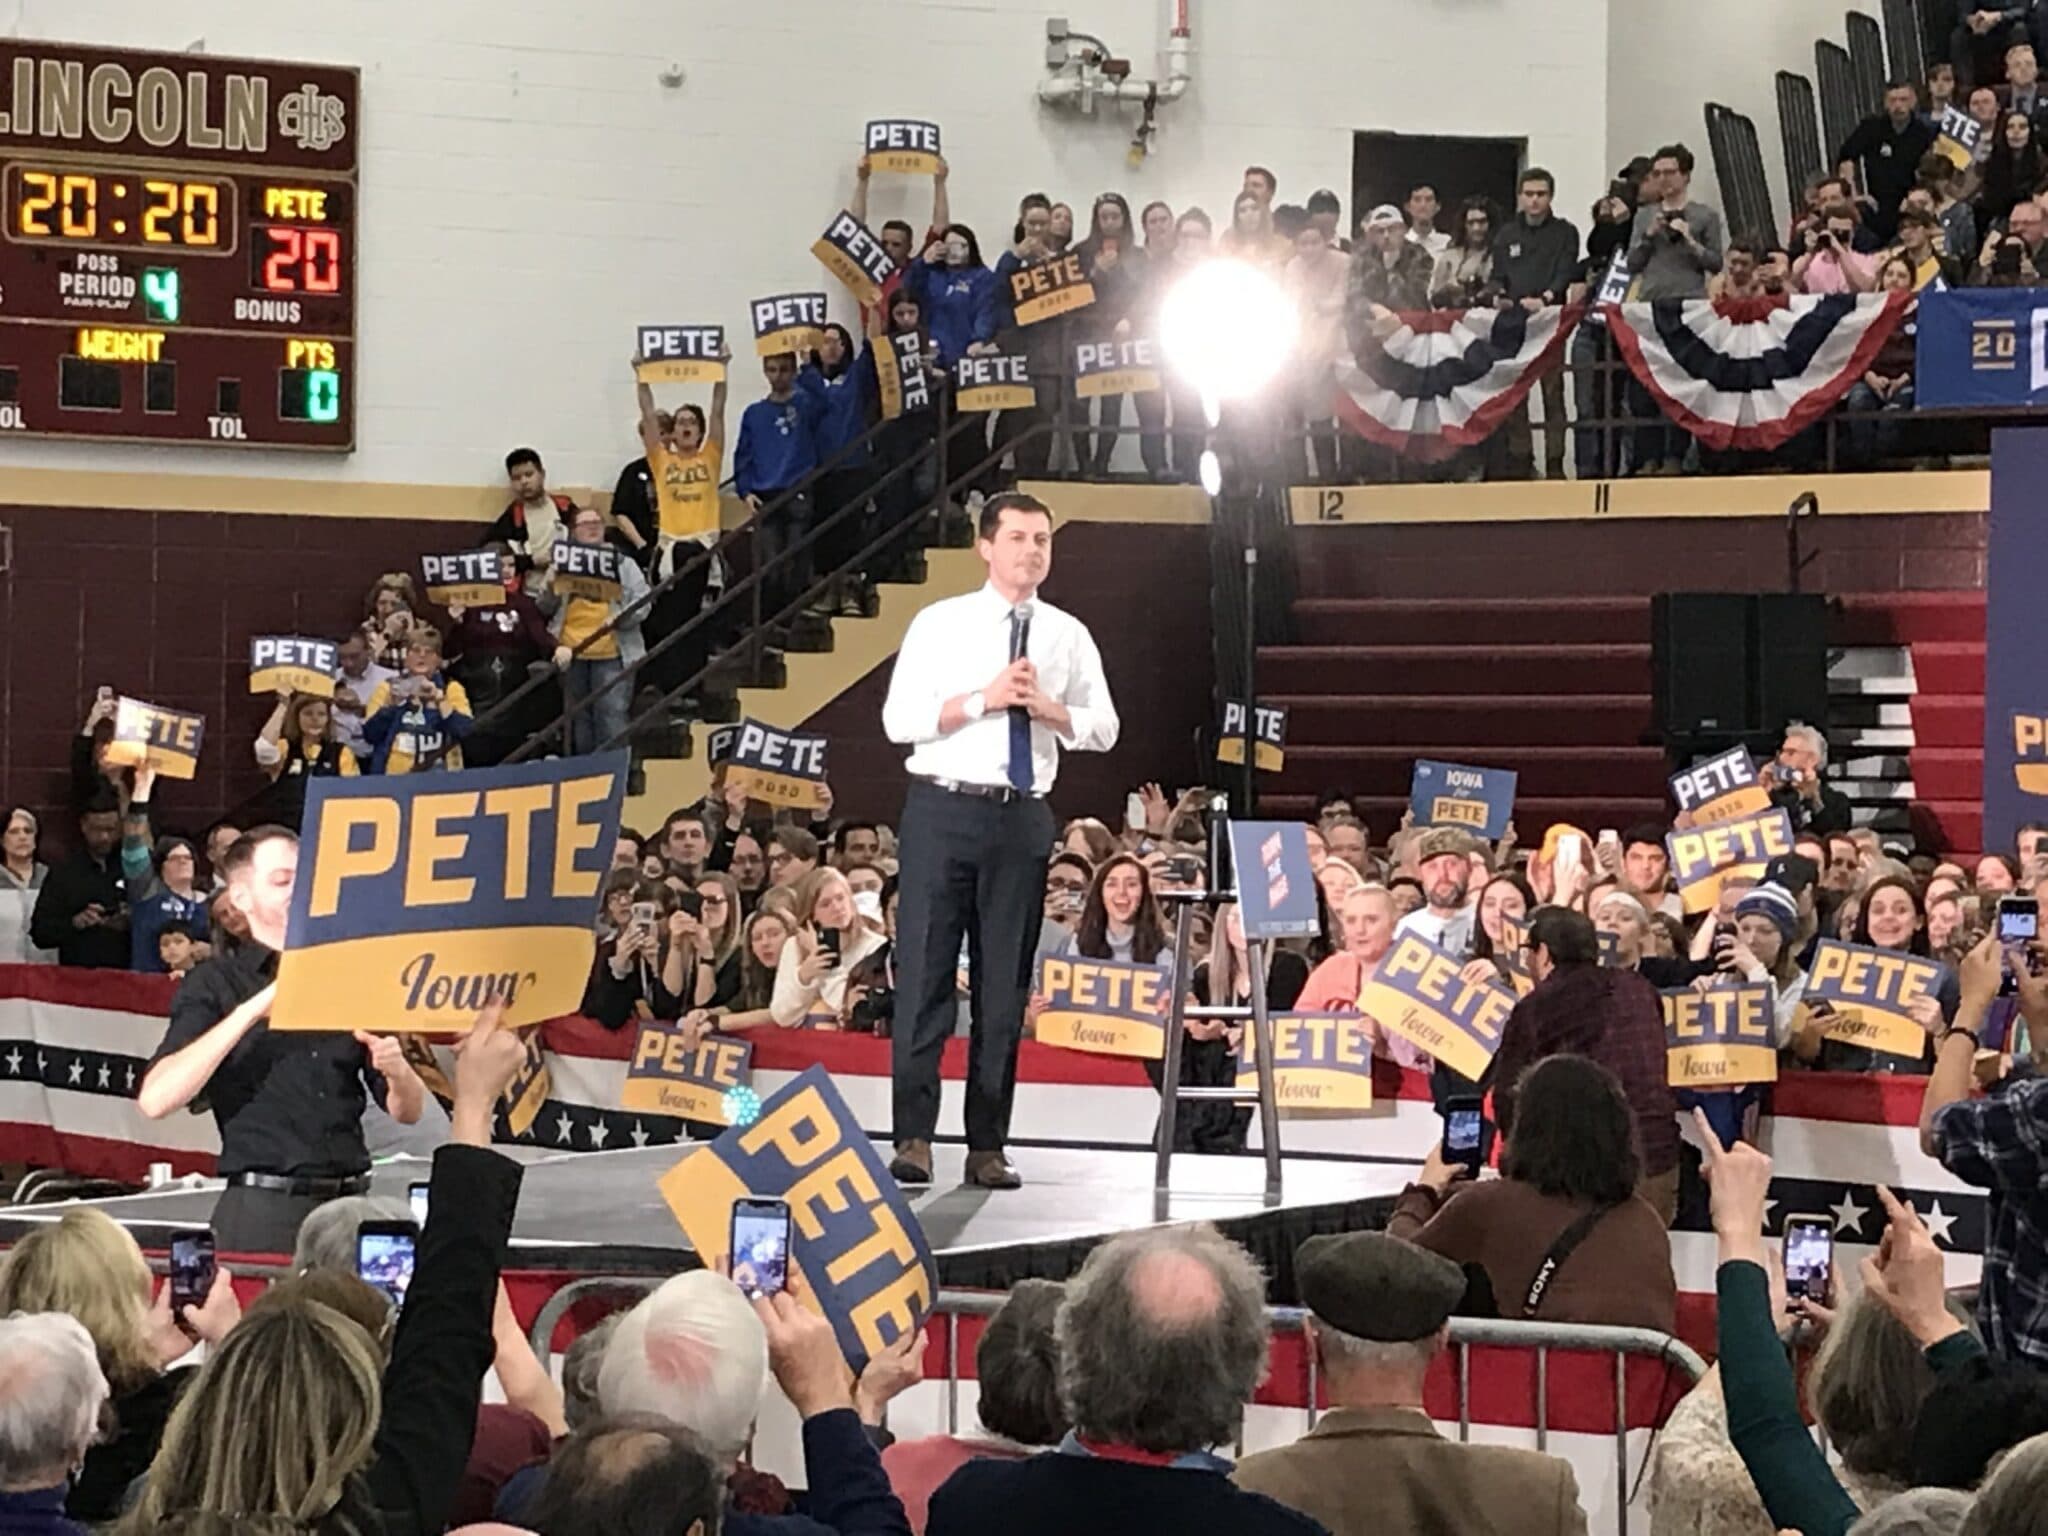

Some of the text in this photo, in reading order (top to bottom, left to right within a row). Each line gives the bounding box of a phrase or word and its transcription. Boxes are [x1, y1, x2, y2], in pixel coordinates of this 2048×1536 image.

[0, 57, 268, 152] INCOLN
[870, 124, 938, 151] PETE
[21, 172, 218, 245] 20:20
[266, 188, 328, 220] PETE
[77, 253, 119, 272] POSS
[265, 229, 340, 291] 20
[830, 215, 896, 284] PETE
[59, 272, 136, 298] PERIOD
[1011, 254, 1085, 301] PETE
[144, 270, 179, 321] 4
[234, 298, 301, 324] BONUS
[755, 297, 825, 332] PETE
[80, 328, 165, 361] WEIGHT
[286, 340, 335, 368] PTS
[643, 329, 720, 358] PETE
[1077, 340, 1154, 374] PETE
[1972, 332, 2015, 357] 20
[895, 332, 929, 410] PETE
[958, 355, 1029, 386] PETE
[308, 369, 340, 421] 0
[0, 407, 26, 430] OL
[207, 416, 247, 440] TOL
[1319, 490, 1344, 520] 12
[1595, 482, 1609, 514] 11
[421, 552, 499, 582] PETE
[553, 543, 617, 579] PETE
[255, 639, 336, 671] PETE
[736, 723, 828, 775] PETE
[1446, 769, 1484, 789] IOWA
[1672, 750, 1752, 811] PETE
[1437, 801, 1485, 823] PETE
[312, 773, 616, 918] PETE
[1671, 813, 1791, 878] PETE
[1042, 958, 1163, 1017] PETE
[1384, 937, 1513, 1041] PETE
[1809, 946, 1938, 1008] PETE
[1071, 1019, 1116, 1045] Iowa
[1398, 1005, 1446, 1048] Iowa
[635, 1029, 747, 1086] PETE
[1681, 1055, 1727, 1084] Iowa
[739, 1086, 934, 1362] PETE
[1527, 1257, 1556, 1305] SONY
